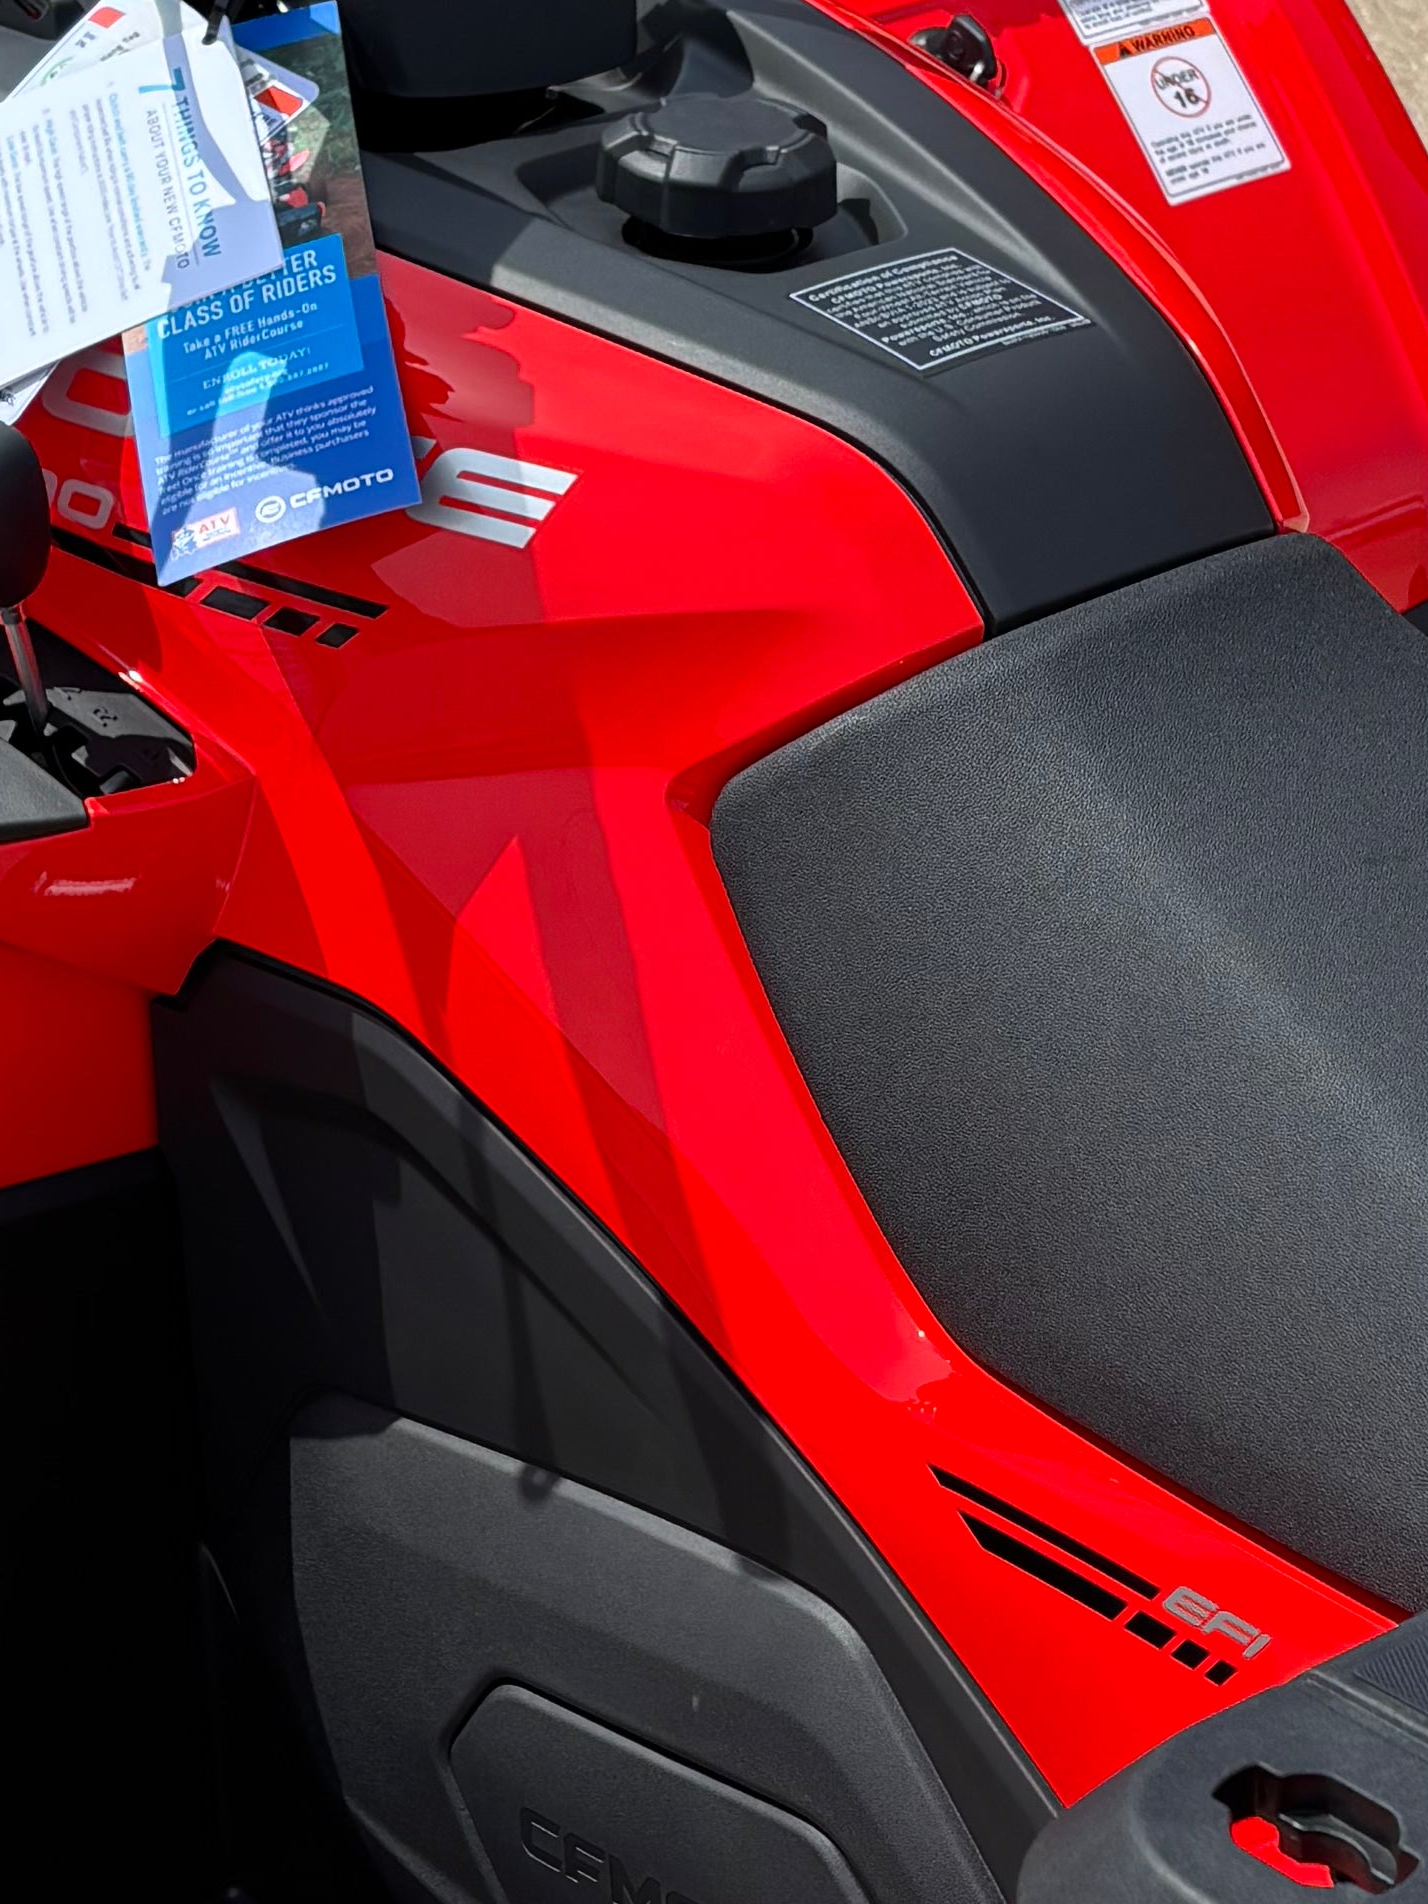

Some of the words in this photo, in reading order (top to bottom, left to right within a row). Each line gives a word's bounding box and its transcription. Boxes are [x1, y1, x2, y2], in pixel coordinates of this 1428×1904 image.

[1130, 24, 1196, 52] WARNING
[138, 67, 185, 95] 7
[1153, 67, 1200, 90] UNDER
[1171, 86, 1201, 110] 16
[146, 108, 165, 149] ABOUT
[172, 96, 201, 168] THINGS
[155, 151, 171, 184] YOUR
[188, 173, 207, 195] TO
[163, 186, 177, 214] NEW
[169, 215, 190, 270] CFMOTO
[193, 199, 222, 257] KNOW
[155, 297, 225, 341] CLASS
[228, 288, 258, 315] OF
[259, 260, 338, 306] RIDERS
[182, 334, 210, 354] Take
[223, 319, 255, 340] FREE
[256, 297, 318, 330] Hands-On
[203, 342, 227, 361] ATV
[229, 315, 304, 352] RiderCourse
[288, 462, 395, 513] CFMOTO
[197, 514, 231, 534] ATV
[1162, 1584, 1272, 1661] EFI
